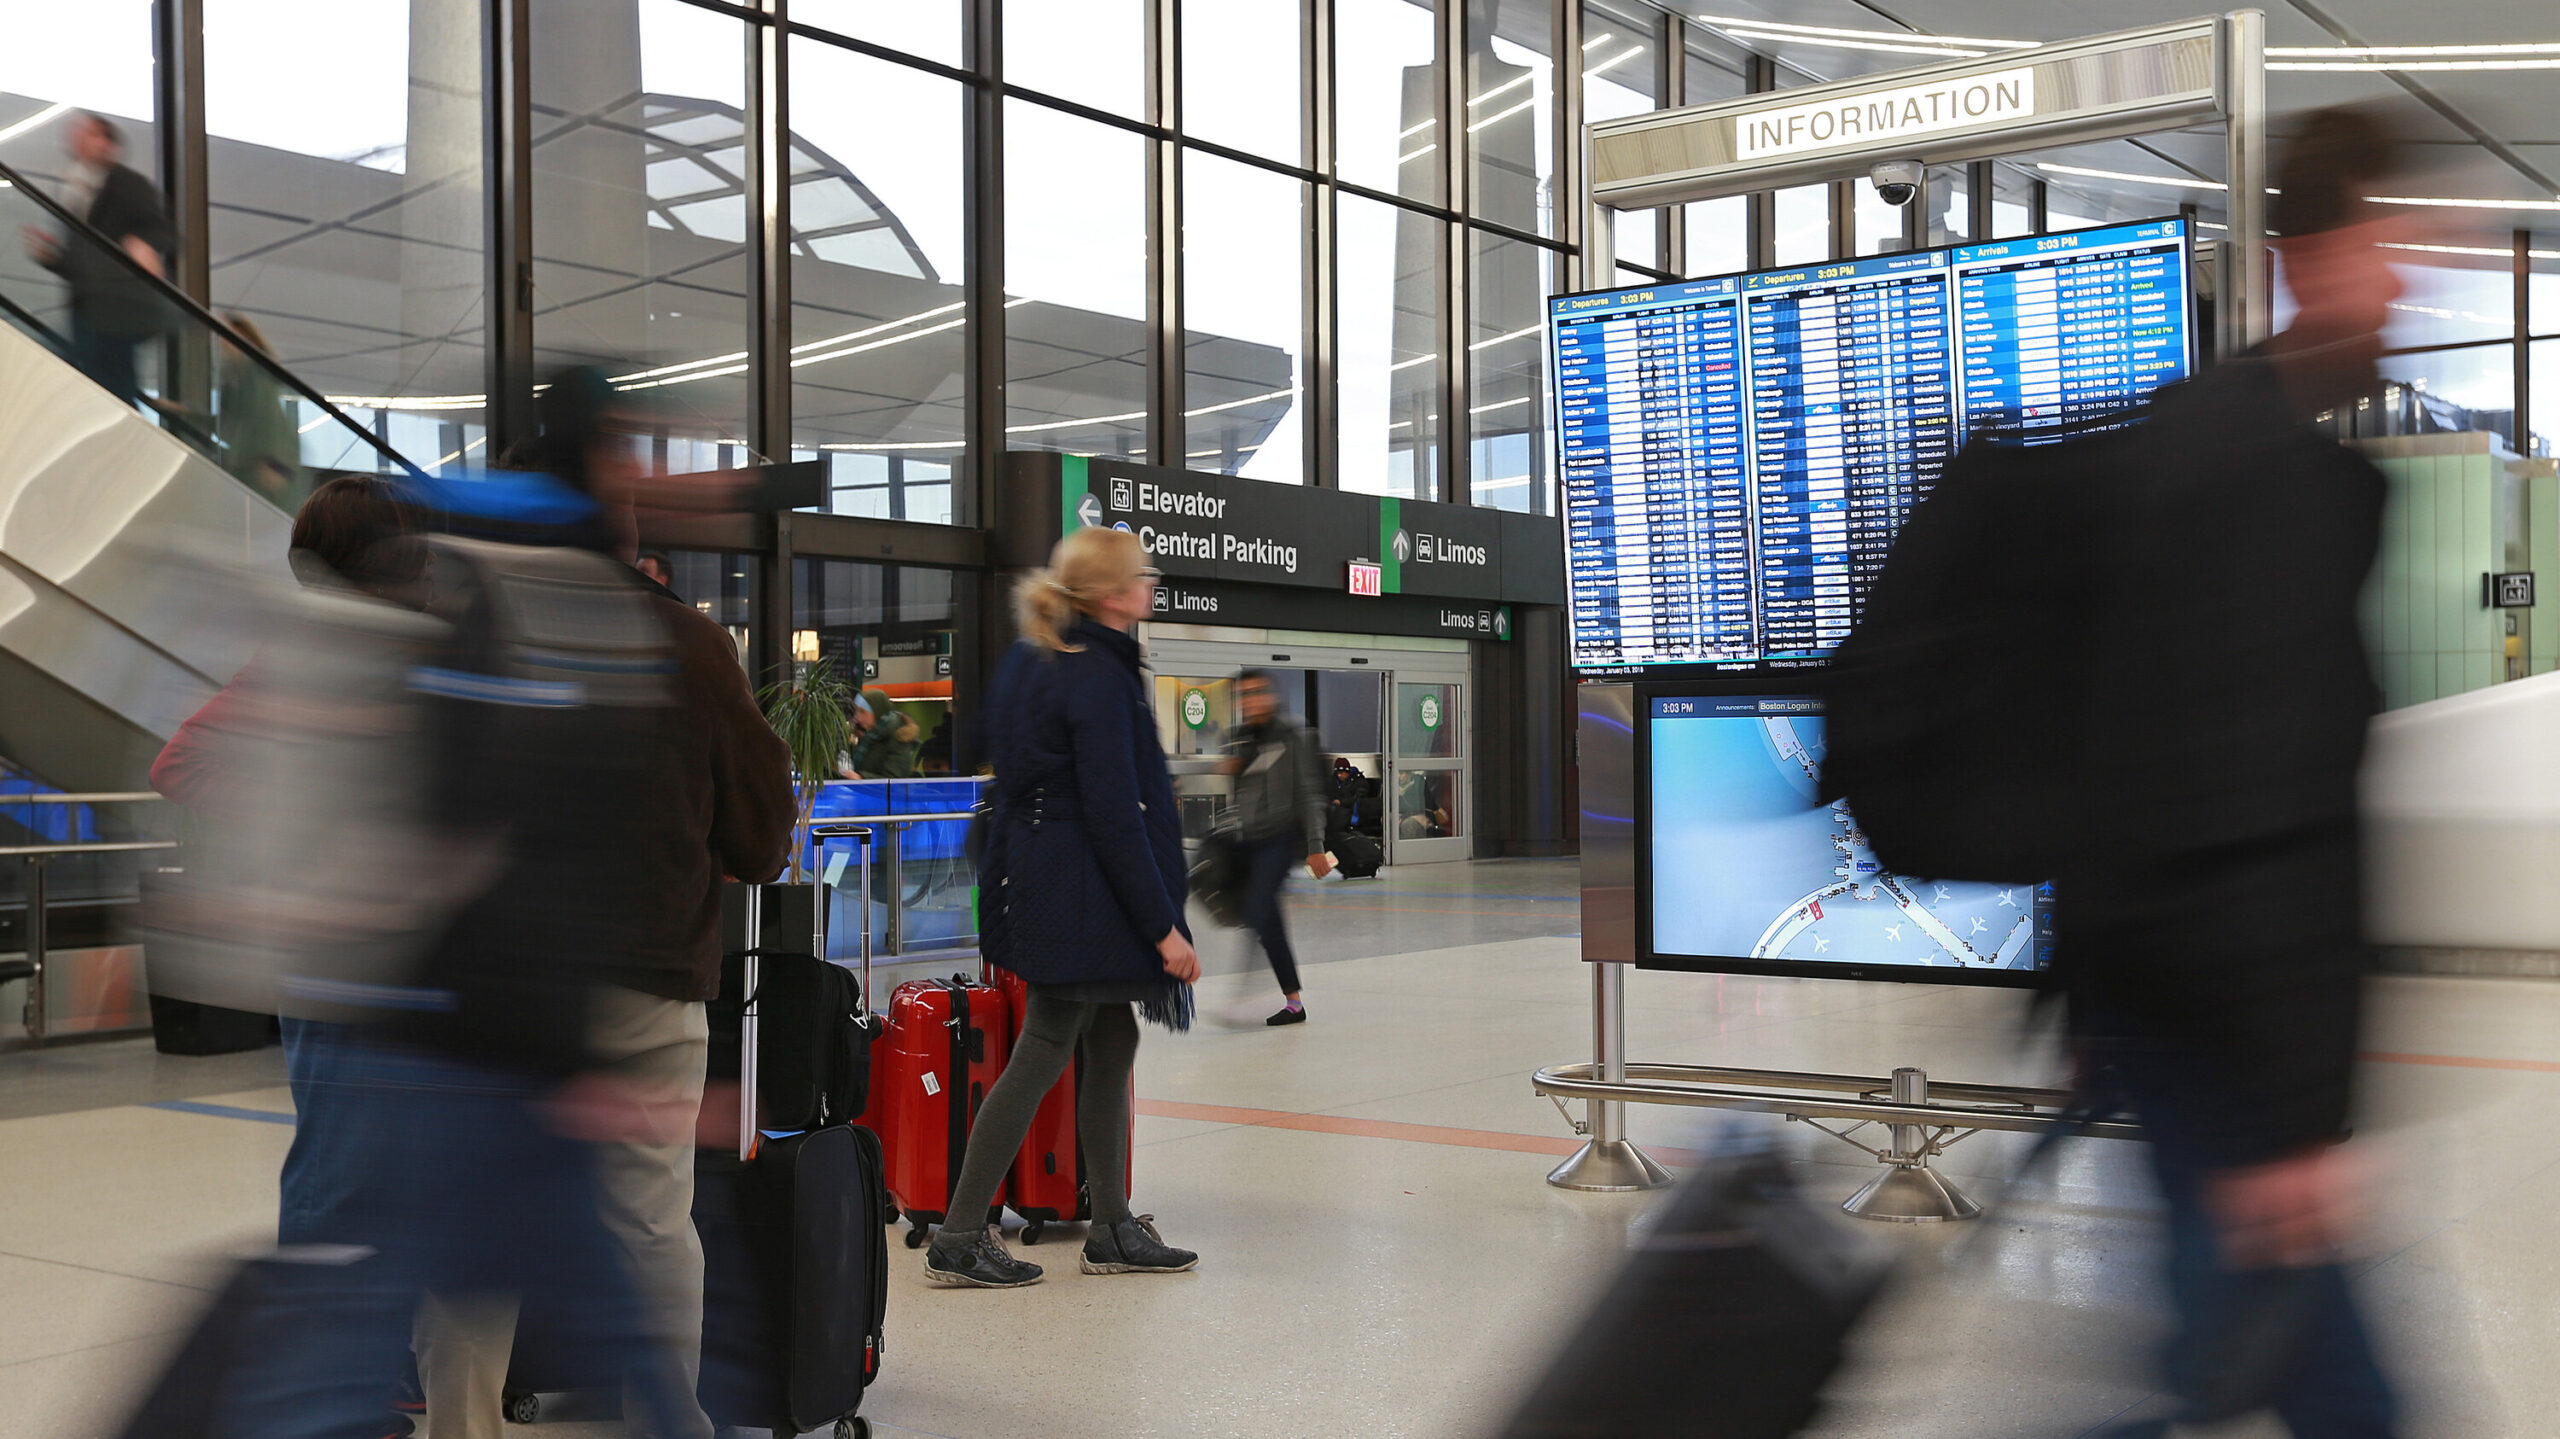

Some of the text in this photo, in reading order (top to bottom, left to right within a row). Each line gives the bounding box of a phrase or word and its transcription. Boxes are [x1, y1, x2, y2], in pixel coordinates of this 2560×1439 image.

[1749, 79, 2020, 150] INFORMATION
[1978, 246, 2008, 256] Arrivals
[2037, 239, 2059, 250] 3:03
[2061, 236, 2078, 247] PM
[2164, 224, 2174, 234] C
[1765, 273, 1805, 285] Departures
[1818, 268, 1838, 279] 3:03
[1840, 265, 1854, 276] PM
[1572, 298, 1609, 309] Departures
[1620, 294, 1638, 304] 3:03
[1640, 292, 1653, 302] PM
[2148, 328, 2164, 336] 4:12
[1139, 483, 1226, 518] Elevator
[1138, 525, 1297, 573] Central Parking
[1438, 537, 1486, 566] Limos
[1353, 566, 1378, 594] EXIT
[1175, 590, 1218, 612] Limos
[1441, 610, 1474, 628] Limos
[1187, 707, 1204, 715] C204
[1662, 702, 1679, 713] 3:03
[1681, 702, 1694, 713] PM
[1788, 702, 1810, 711] Logan
